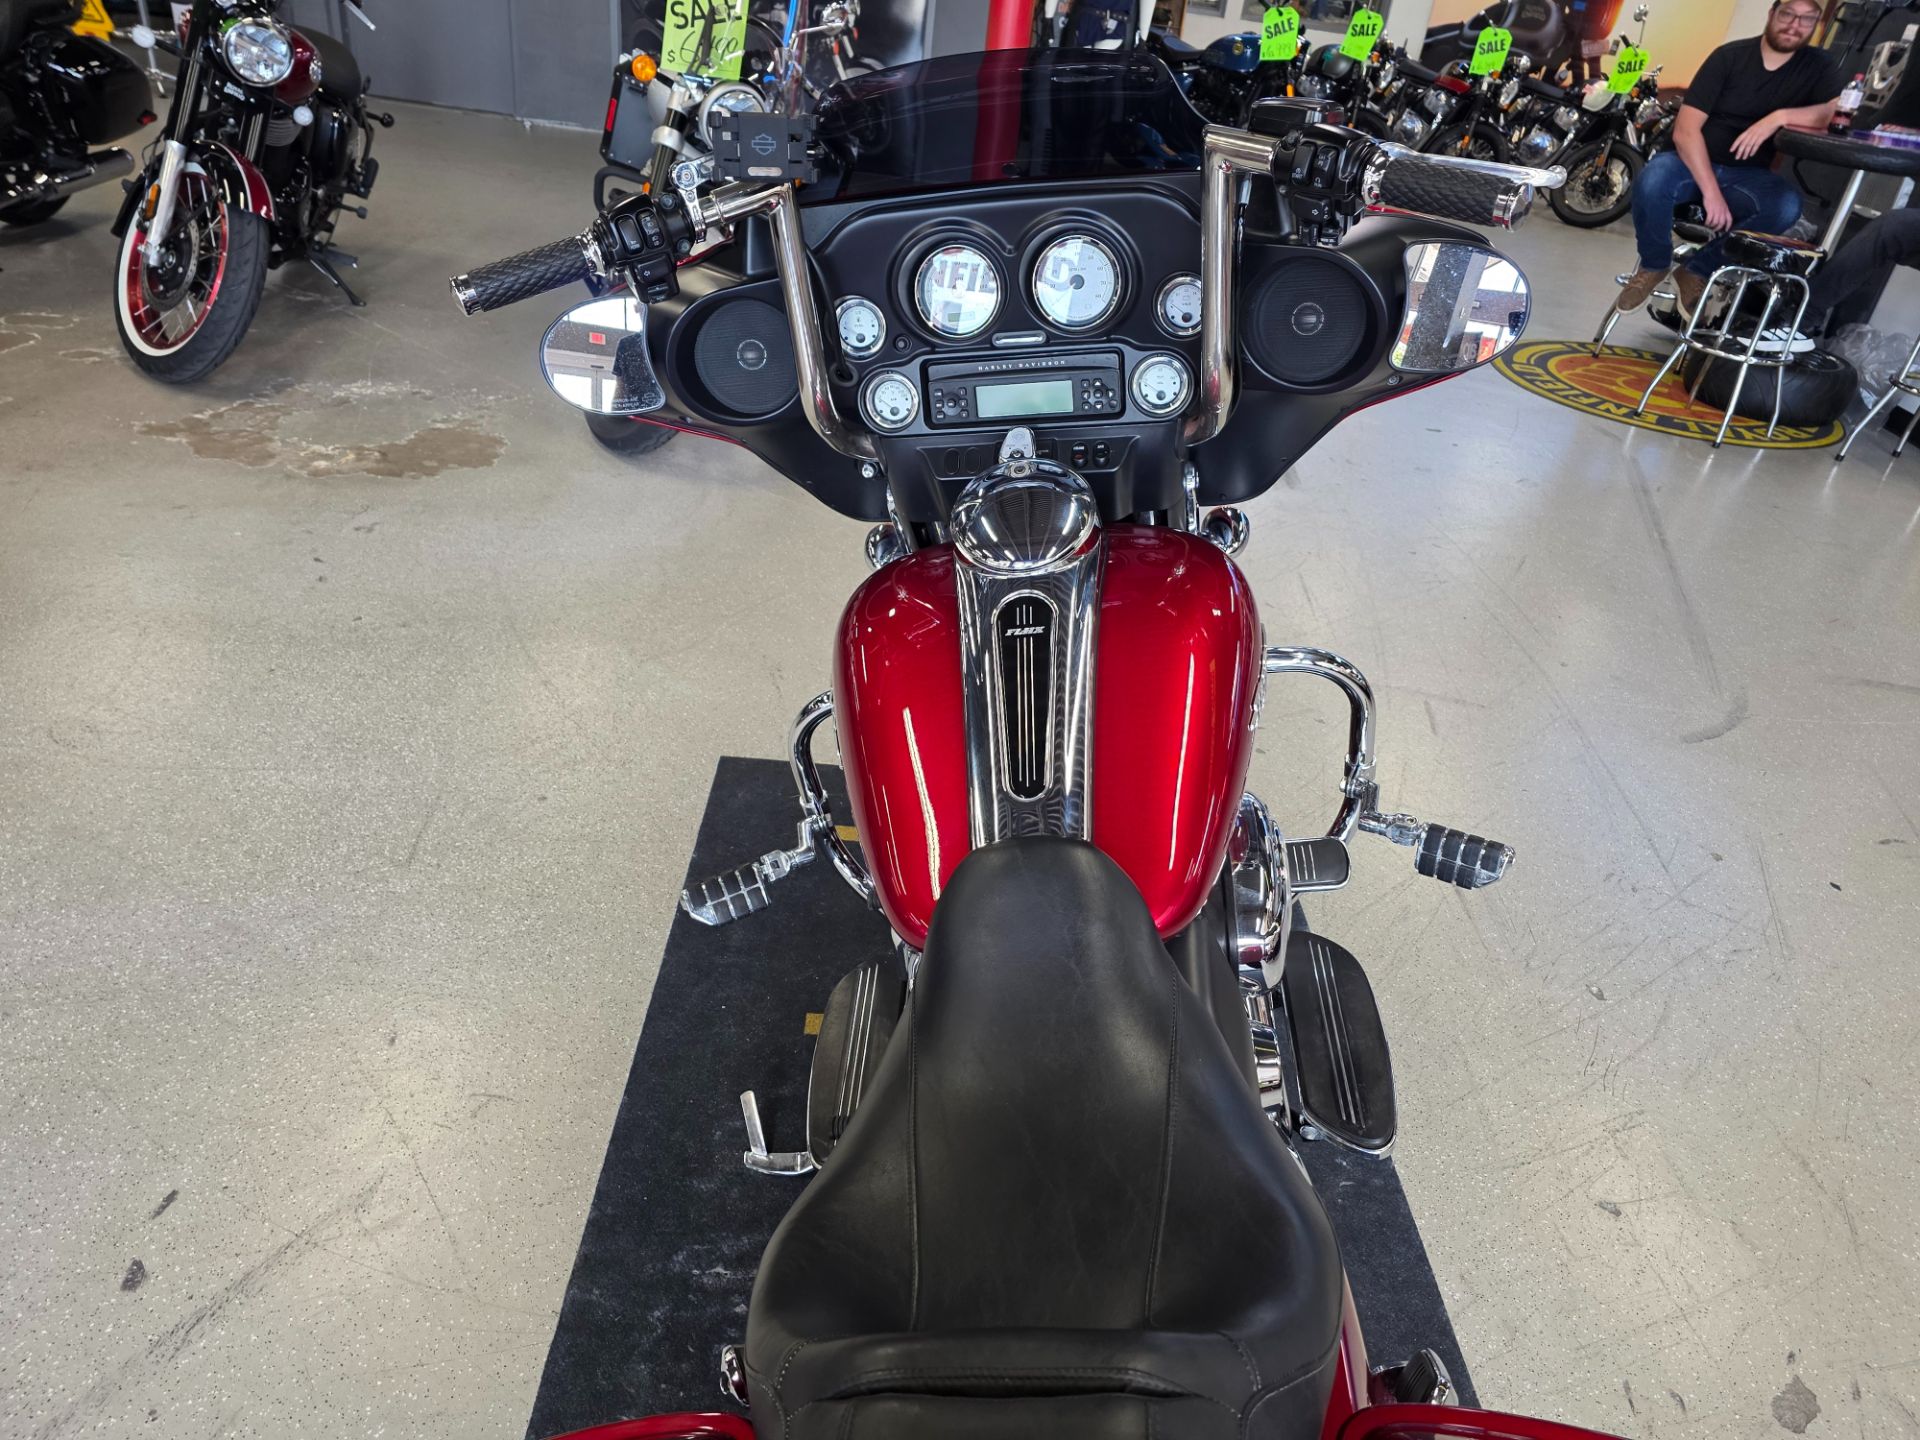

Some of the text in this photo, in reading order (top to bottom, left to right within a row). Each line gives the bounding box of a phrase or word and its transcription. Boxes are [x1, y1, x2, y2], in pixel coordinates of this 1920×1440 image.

[1264, 17, 1295, 40] SALE
[1351, 23, 1378, 37] SALE
[1478, 38, 1506, 55] SALE
[1617, 59, 1646, 74] SALE
[978, 360, 1065, 371] HARLEY DAVIDSON
[1511, 363, 1660, 424] ENFIELD
[1004, 625, 1046, 636] FLHX
